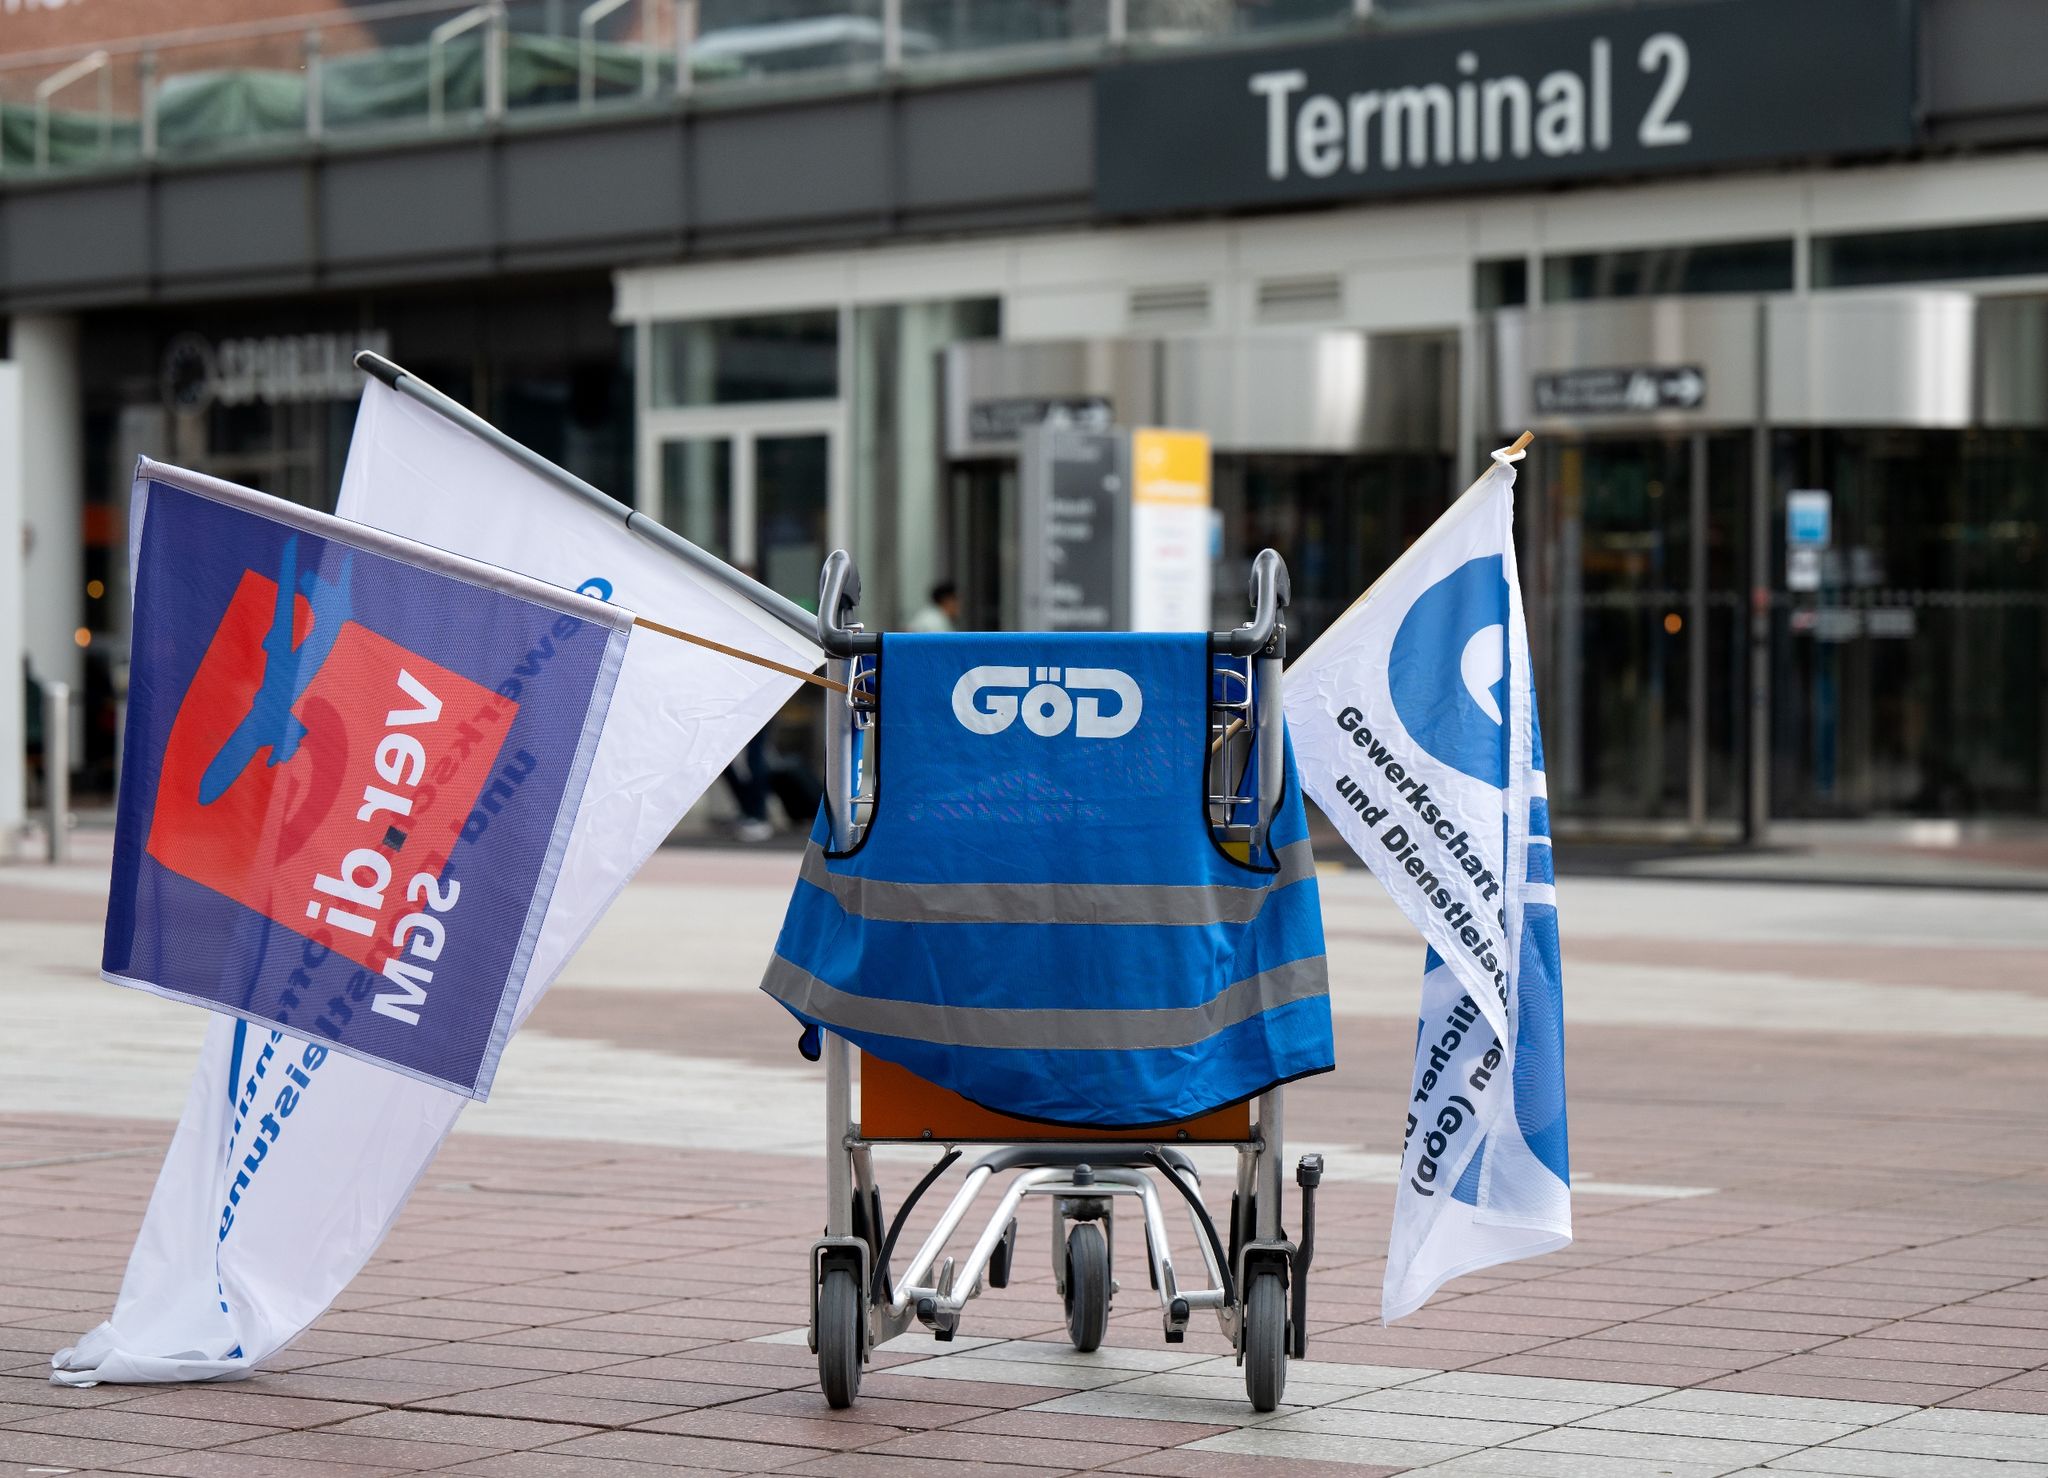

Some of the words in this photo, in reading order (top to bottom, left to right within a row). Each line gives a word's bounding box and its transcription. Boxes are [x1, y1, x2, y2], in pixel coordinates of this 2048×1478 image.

[1248, 37, 1611, 181] Terminal
[1638, 33, 1692, 147] 2
[952, 665, 1143, 739] GÖD
[1336, 775, 1389, 829] und
[1336, 706, 1500, 903] Gewerkschaft
